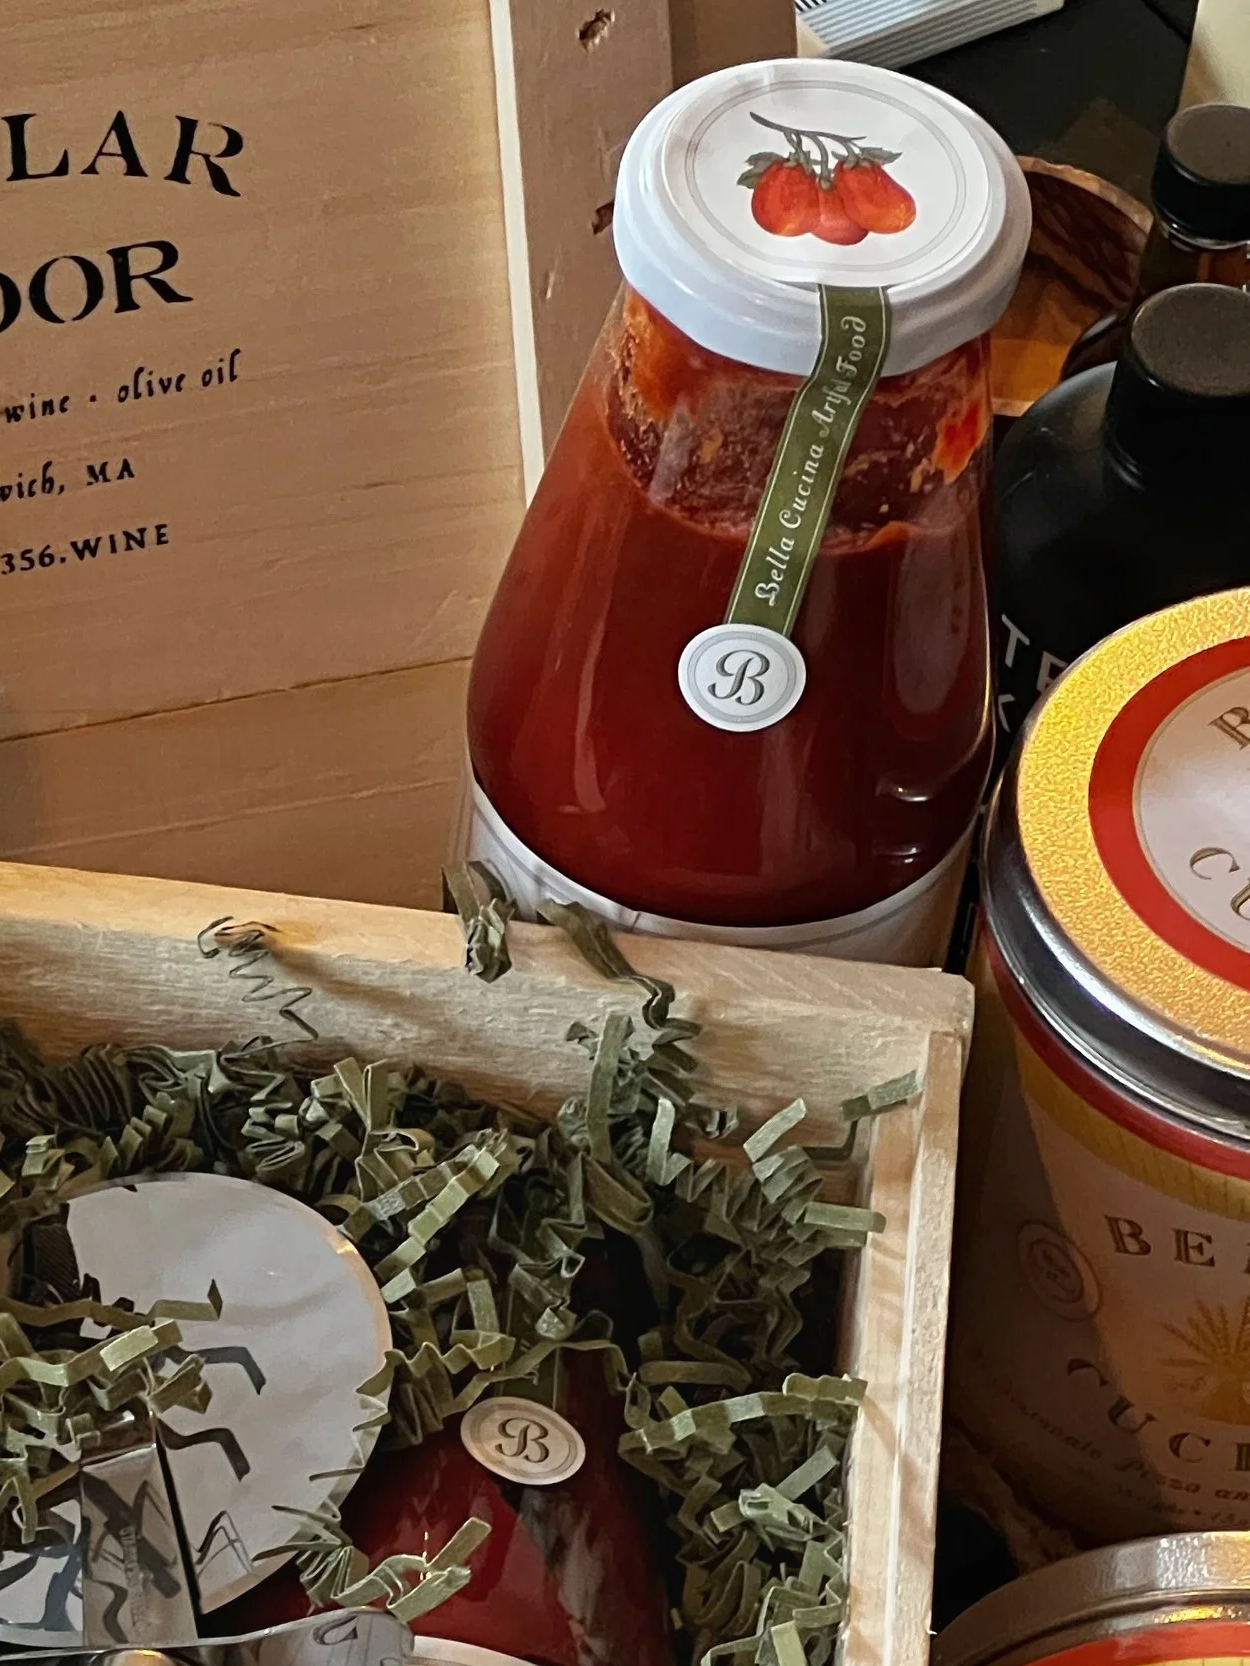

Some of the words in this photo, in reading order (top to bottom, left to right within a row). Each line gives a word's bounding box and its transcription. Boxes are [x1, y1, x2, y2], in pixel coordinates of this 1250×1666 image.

[5, 393, 69, 423] wine
[118, 367, 185, 404] olive
[202, 349, 241, 389] oil
[86, 459, 135, 486] MA
[755, 536, 794, 606] Bella
[779, 444, 823, 528] Cucina
[836, 315, 867, 376] Food
[707, 649, 770, 705] B
[495, 1417, 549, 1463] B
